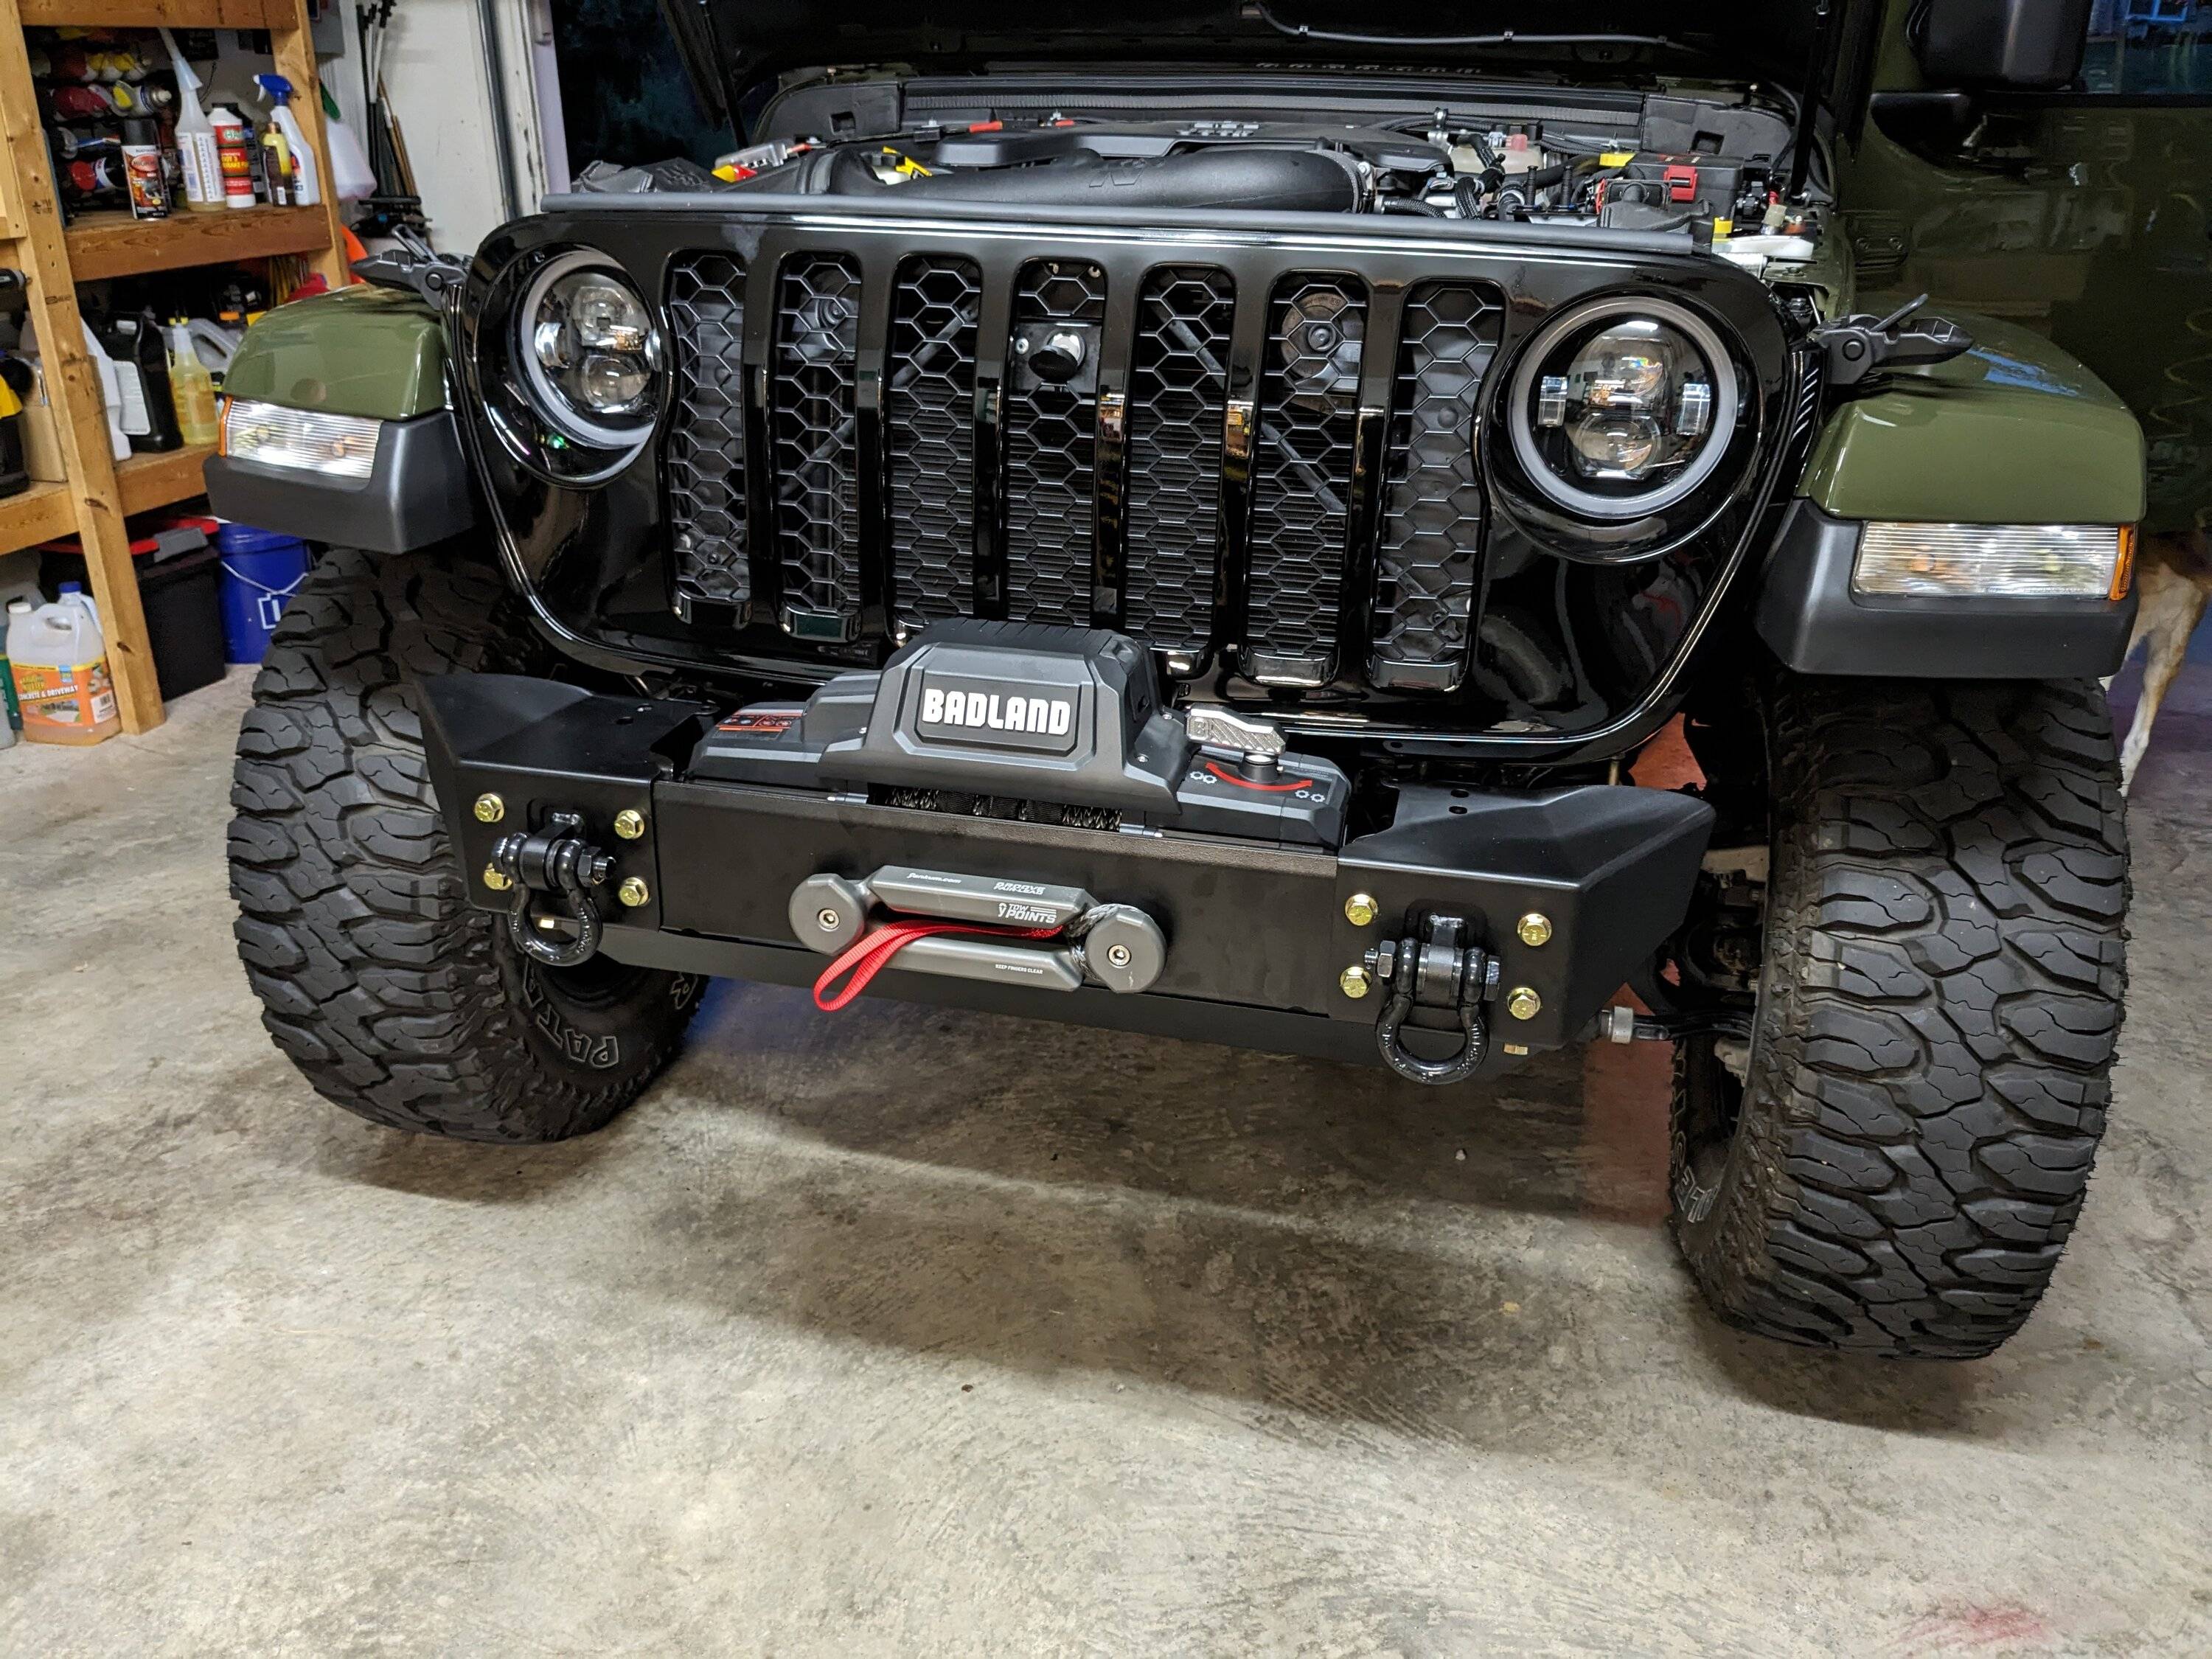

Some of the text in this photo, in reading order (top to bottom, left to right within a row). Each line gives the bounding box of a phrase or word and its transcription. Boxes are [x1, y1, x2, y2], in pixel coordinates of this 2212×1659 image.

[46, 684, 79, 697] DRIVEWAY
[922, 688, 1071, 736] BADLAND
[1008, 903, 1029, 911] TOW
[1004, 909, 1057, 924] POINTS
